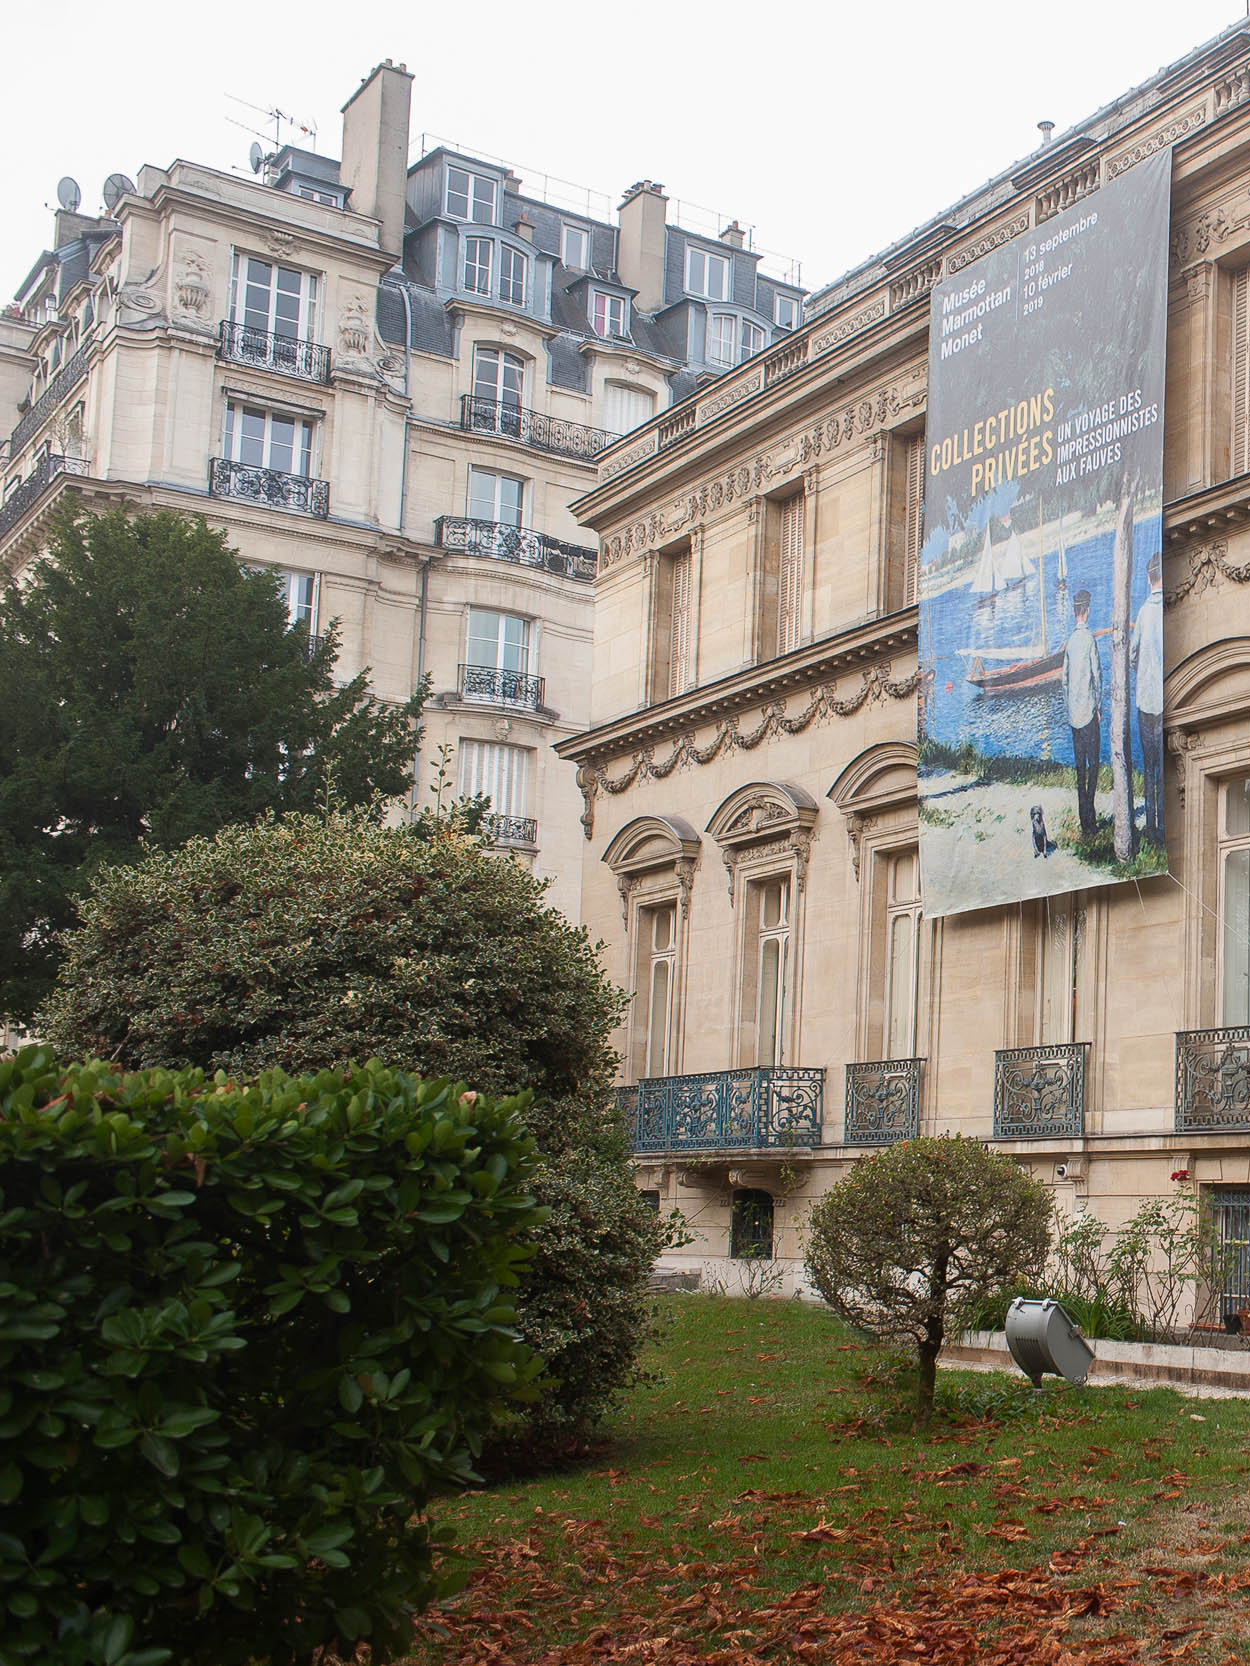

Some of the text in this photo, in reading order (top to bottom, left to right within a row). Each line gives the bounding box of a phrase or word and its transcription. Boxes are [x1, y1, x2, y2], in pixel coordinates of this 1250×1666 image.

[1024, 212, 1098, 263] 13 septembre
[1024, 263, 1044, 279] 2018
[1024, 261, 1073, 299] 10 février
[942, 278, 986, 314] Musée
[942, 286, 1011, 337] Marmottan
[1023, 297, 1043, 315] 2019
[941, 323, 983, 360] Monet
[931, 388, 1054, 476] COLLECTIONS
[1057, 389, 1142, 442] UN VOYAGE DES
[1057, 403, 1158, 464] IMPRESSIONNISTES
[971, 431, 1053, 496] PRIVÉES
[1056, 442, 1121, 486] AUX FAUVES
